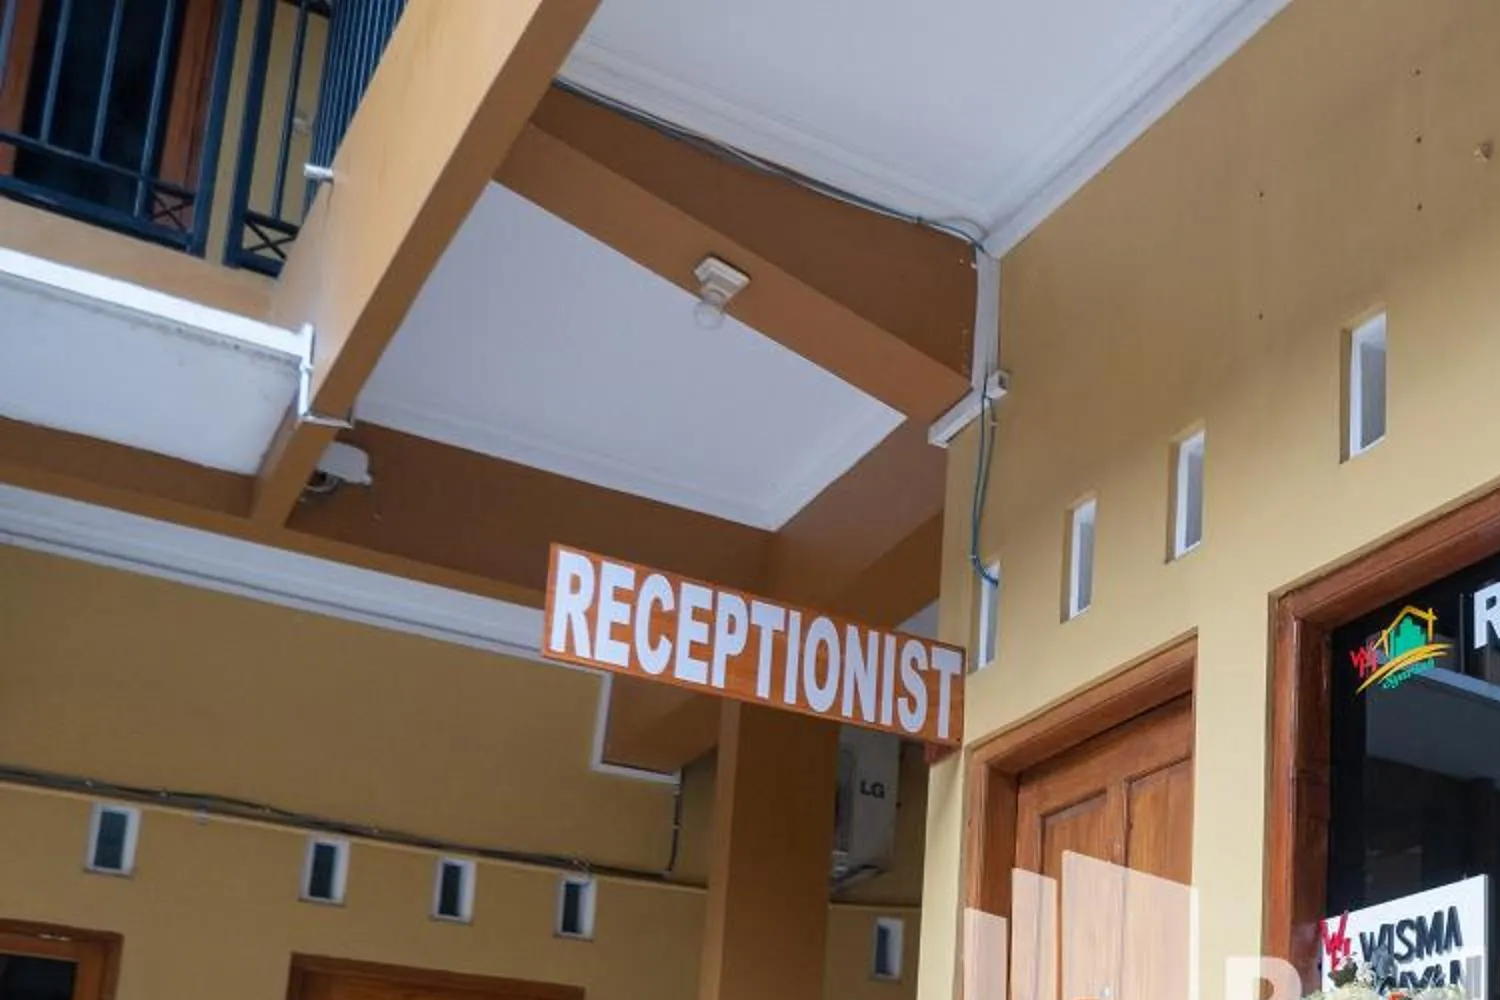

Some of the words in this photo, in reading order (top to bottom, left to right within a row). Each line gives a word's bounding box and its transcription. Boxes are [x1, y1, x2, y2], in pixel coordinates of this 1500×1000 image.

[550, 549, 963, 739] RECEPTIONIST
[860, 780, 886, 800] LG
[1359, 905, 1464, 962] WISMA
